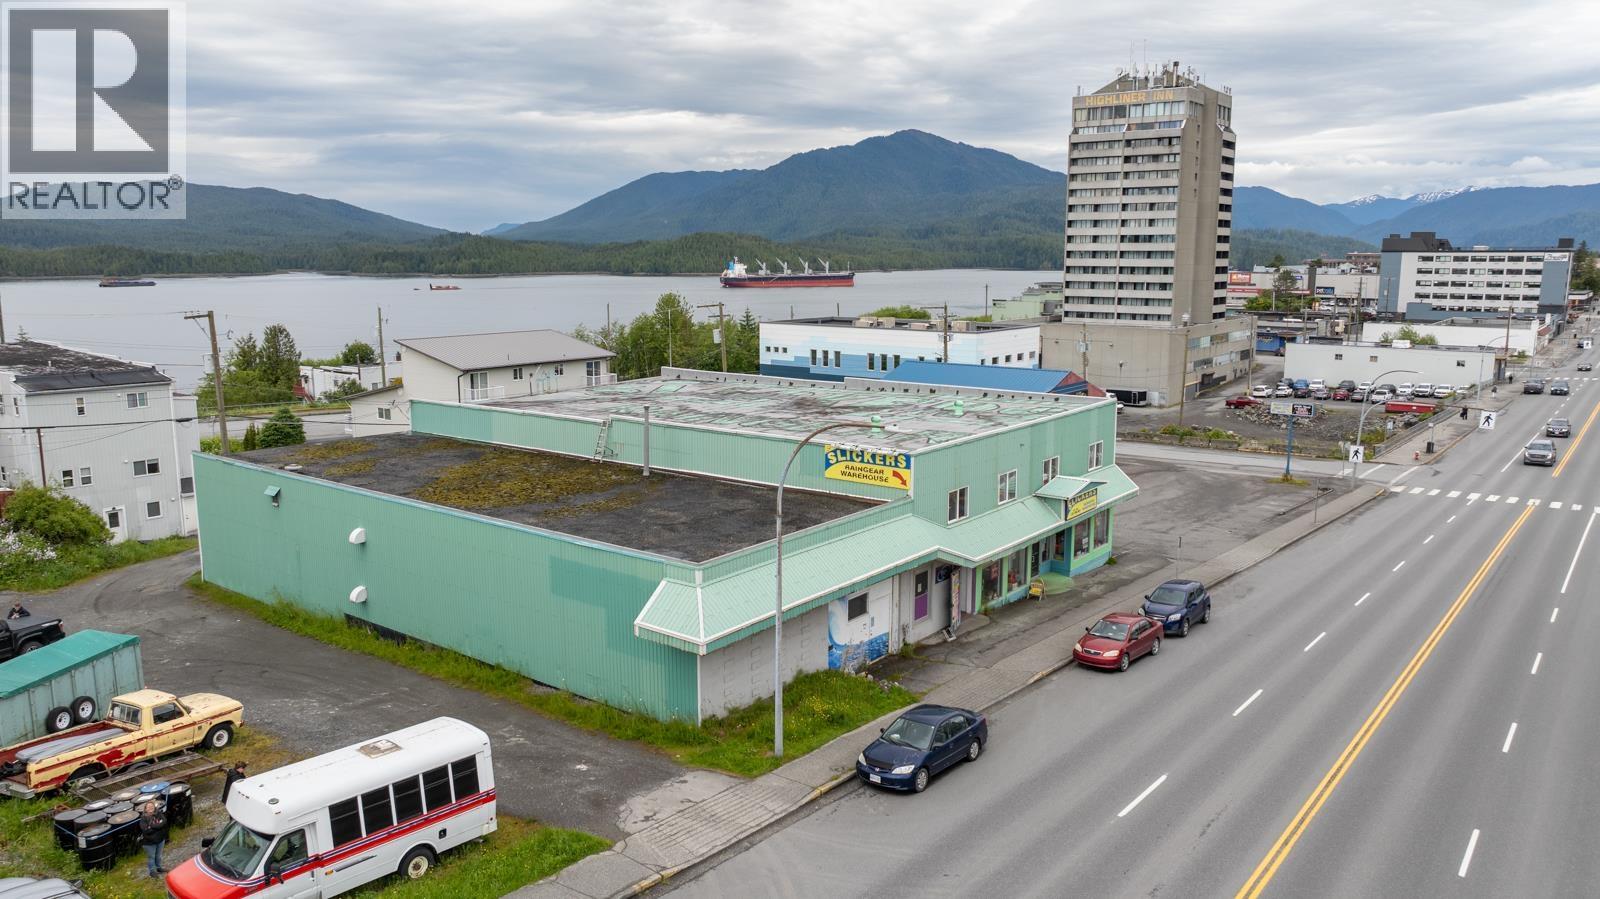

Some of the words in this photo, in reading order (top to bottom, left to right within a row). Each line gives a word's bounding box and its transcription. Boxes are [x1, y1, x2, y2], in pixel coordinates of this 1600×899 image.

[1085, 92, 1146, 106] HIGHLINER
[1152, 90, 1174, 100] INN
[827, 448, 907, 469] SLICKERS
[840, 470, 889, 483] WAREHOUSE
[844, 464, 885, 475] RAINGEAR
